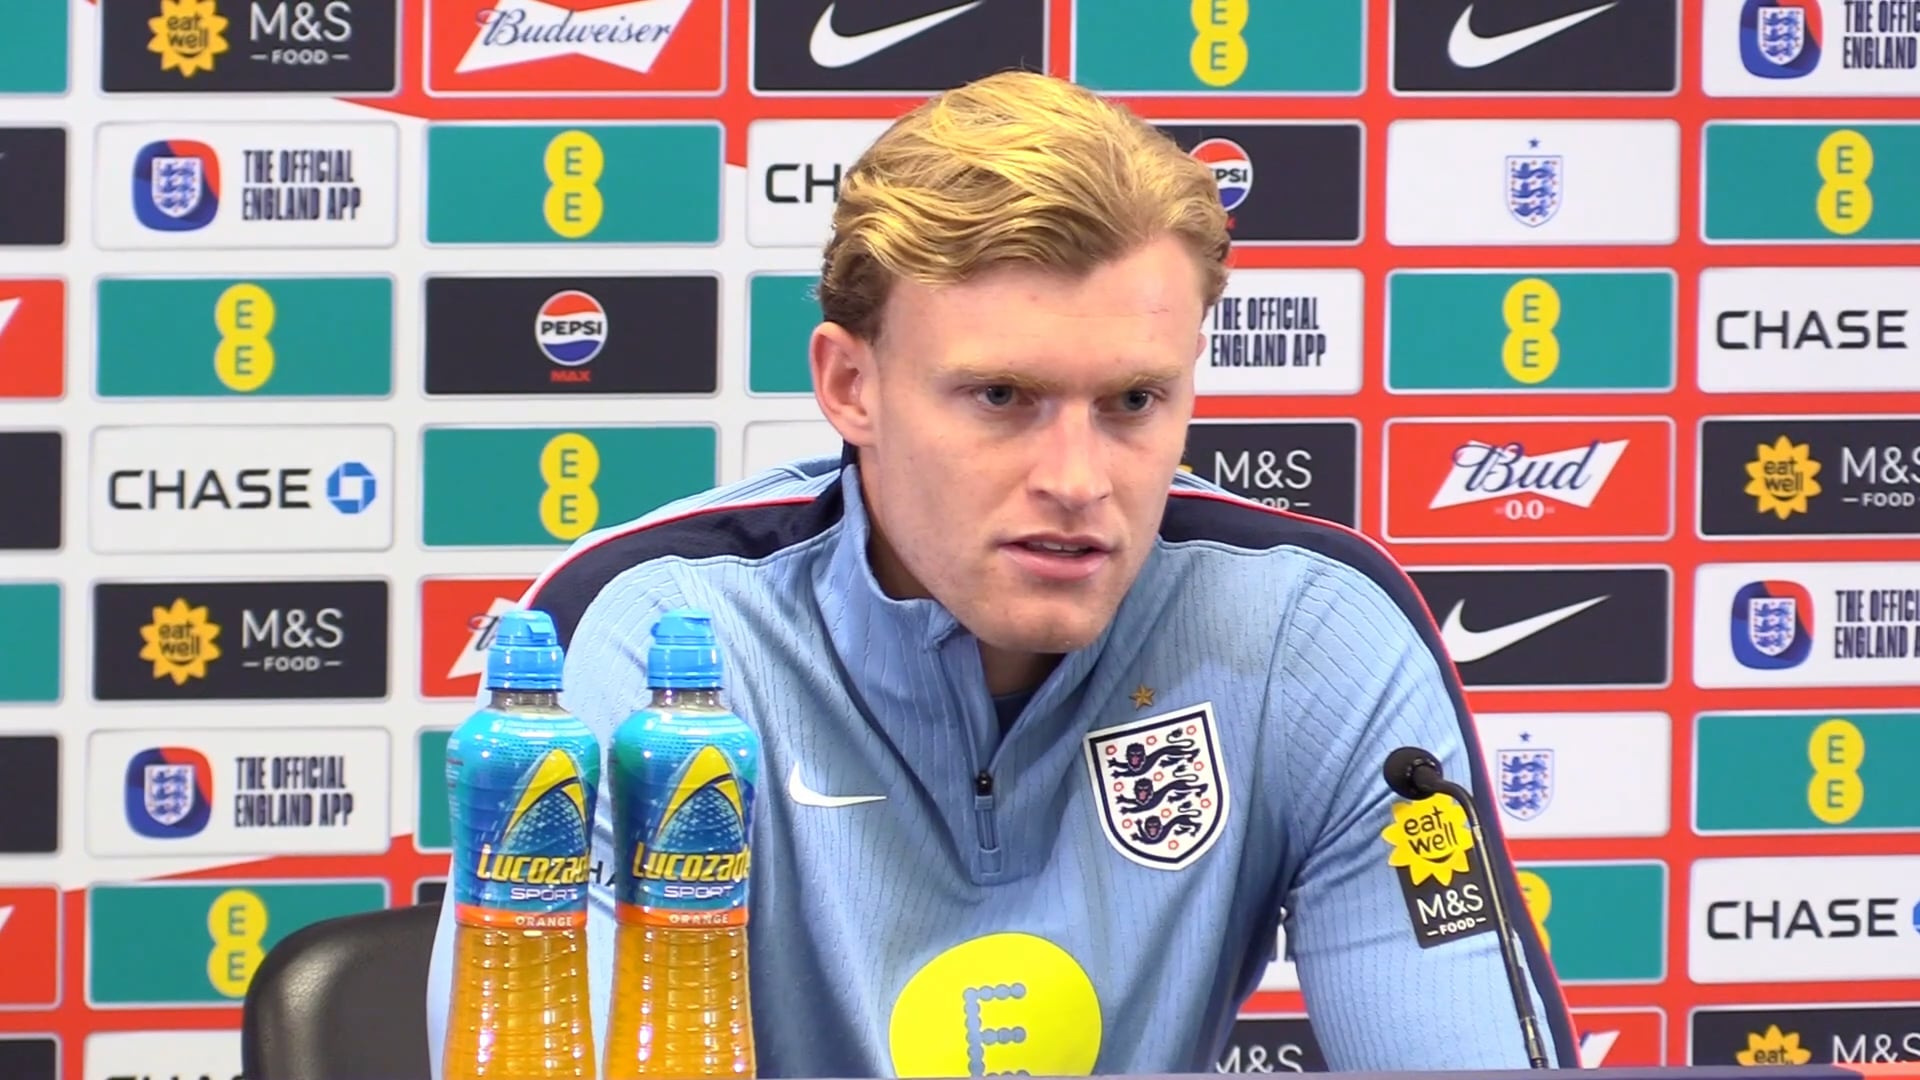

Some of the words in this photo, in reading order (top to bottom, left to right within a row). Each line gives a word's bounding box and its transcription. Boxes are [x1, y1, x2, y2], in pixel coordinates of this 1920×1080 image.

[167, 13, 202, 31] eat
[250, 1, 352, 42] M&S
[476, 8, 671, 46] Budweiser
[1844, 0, 1873, 32] THE
[1879, 0, 1920, 32] OFFIC
[168, 26, 208, 48] well
[1843, 36, 1917, 69] ENGLAND
[272, 50, 329, 64] FOOD
[243, 150, 275, 183] THE
[280, 150, 354, 183] OFFICIAL
[1215, 168, 1248, 183] PSI
[242, 188, 320, 220] ENGLAND
[327, 187, 361, 220] APP
[541, 321, 602, 336] PEPSI
[1214, 297, 1243, 330] THE
[1247, 297, 1319, 330] OFFICIAL
[1717, 310, 1909, 350] CHASE
[1211, 334, 1287, 367] ENGLAND
[1293, 334, 1326, 367] APP
[551, 370, 591, 382] MAX
[1214, 450, 1312, 489] M&S
[1453, 440, 1600, 492] Bud
[1764, 457, 1797, 475] eat
[1765, 472, 1804, 492] well
[108, 469, 312, 510] CHASE
[1863, 493, 1915, 507] FOOD
[1835, 590, 1864, 622] THE
[1870, 590, 1920, 622] OFFICI
[158, 620, 195, 639] eat
[160, 633, 201, 656] well
[242, 608, 344, 649] M&S
[1835, 626, 1908, 658] ENGLAND
[264, 657, 320, 672] FOOD
[235, 757, 266, 789] THE
[272, 757, 346, 789] OFFICIAL
[235, 794, 312, 827] ENGLAND
[319, 793, 354, 826] APP
[1404, 806, 1442, 835] eat
[1408, 822, 1458, 855] well
[511, 888, 578, 900] SPORT
[664, 886, 733, 898] SPORT
[1417, 884, 1484, 925] M&S
[515, 917, 573, 926] ORANGE
[669, 914, 729, 924] ORANGE
[1439, 917, 1476, 935] FOOD
[1707, 899, 1899, 939] CHASE
[1754, 1047, 1787, 1064] eat
